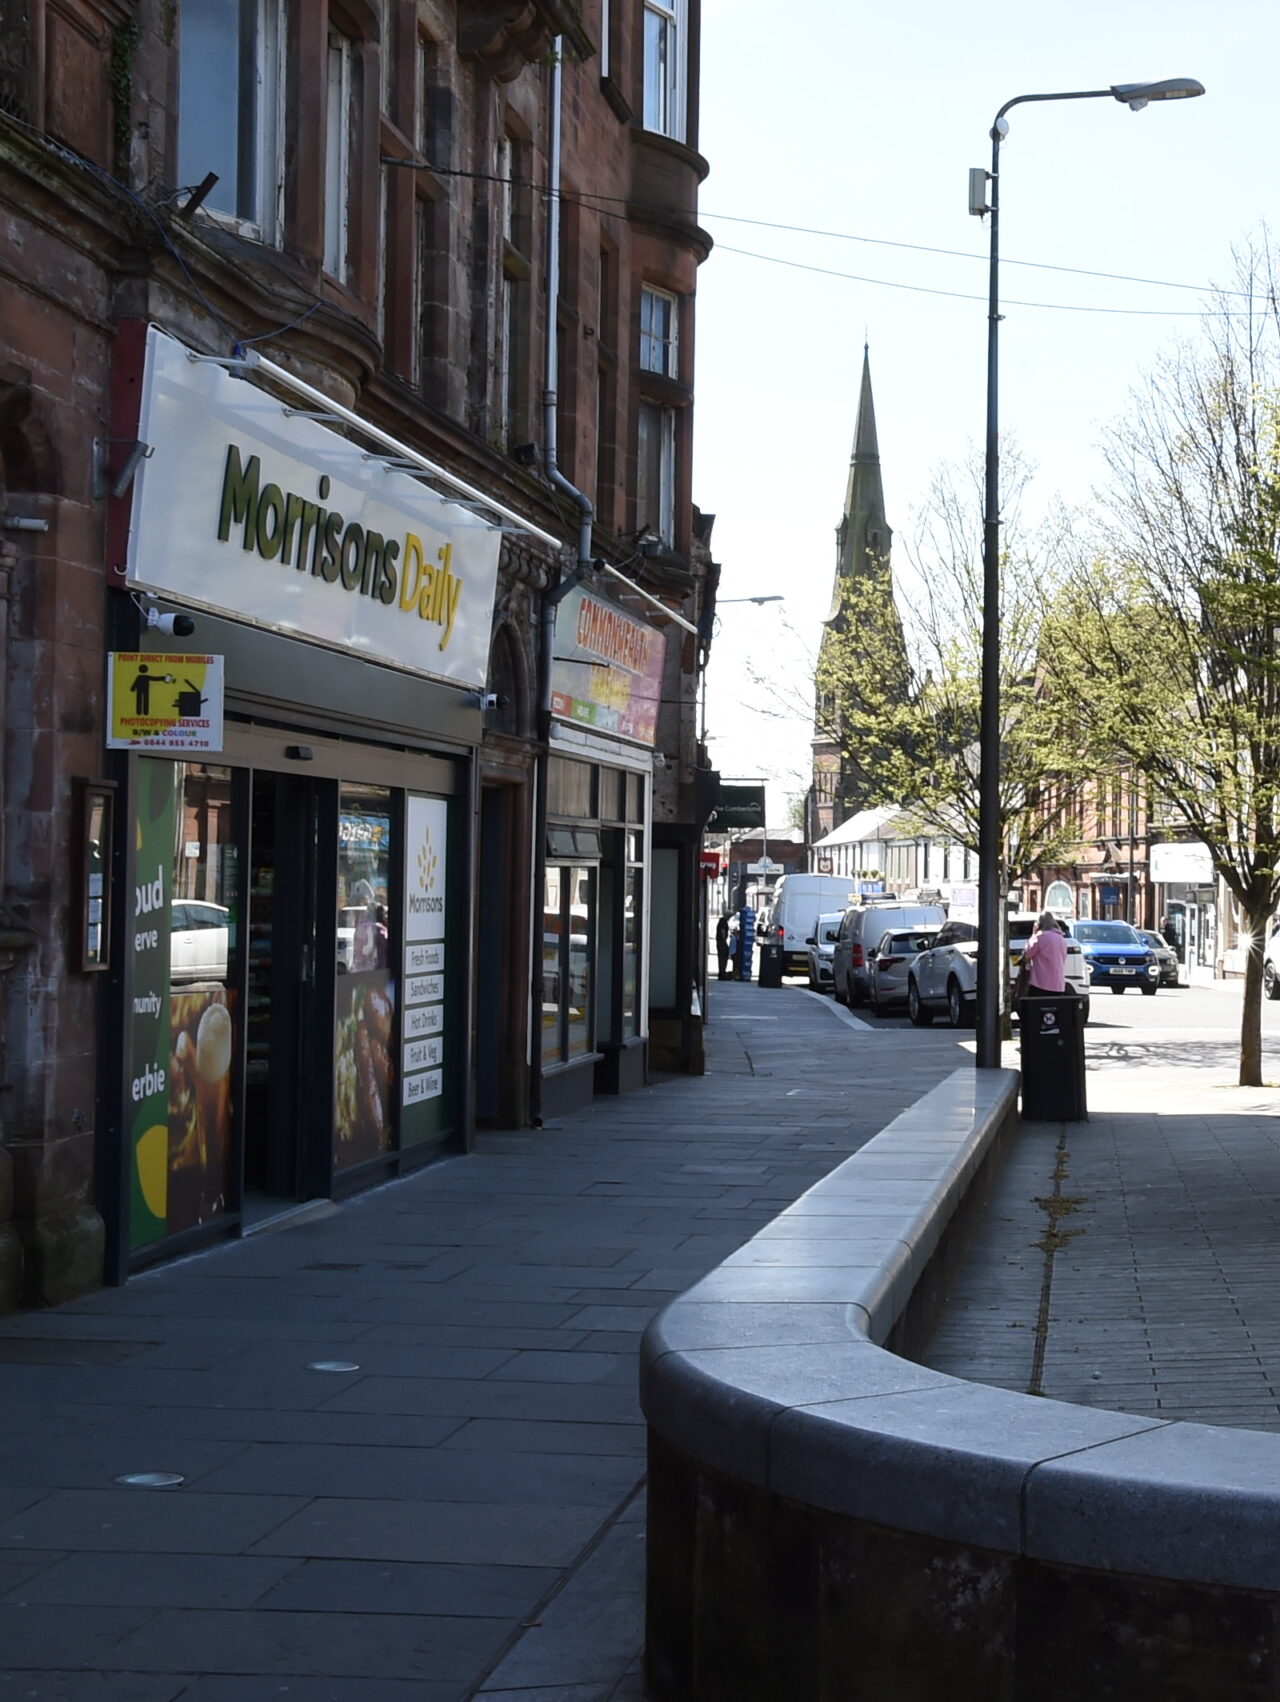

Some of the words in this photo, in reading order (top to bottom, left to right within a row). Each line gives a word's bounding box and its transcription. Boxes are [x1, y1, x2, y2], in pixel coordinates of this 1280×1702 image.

[217, 444, 401, 606] Morrisons
[399, 532, 463, 651] Daily
[118, 653, 138, 662] PRINT
[140, 654, 162, 663] DIRECT
[164, 655, 184, 664] FROM
[185, 655, 214, 664] MOBILES
[120, 717, 176, 728] PHOTOCOPYING
[178, 719, 210, 729] SERVICES
[408, 893, 443, 914] Morrisons
[135, 929, 158, 952] erve
[411, 949, 424, 967] Fresh
[425, 946, 440, 965] Foods
[410, 977, 439, 998] Sandwiches
[411, 1013, 422, 1030] Hot
[422, 1010, 438, 1028] Drinks
[410, 1046, 422, 1064] Fruit
[428, 1044, 437, 1063] Veg
[132, 1062, 166, 1101] erbie
[408, 1081, 420, 1098] Beer
[425, 1076, 438, 1092] Wine
